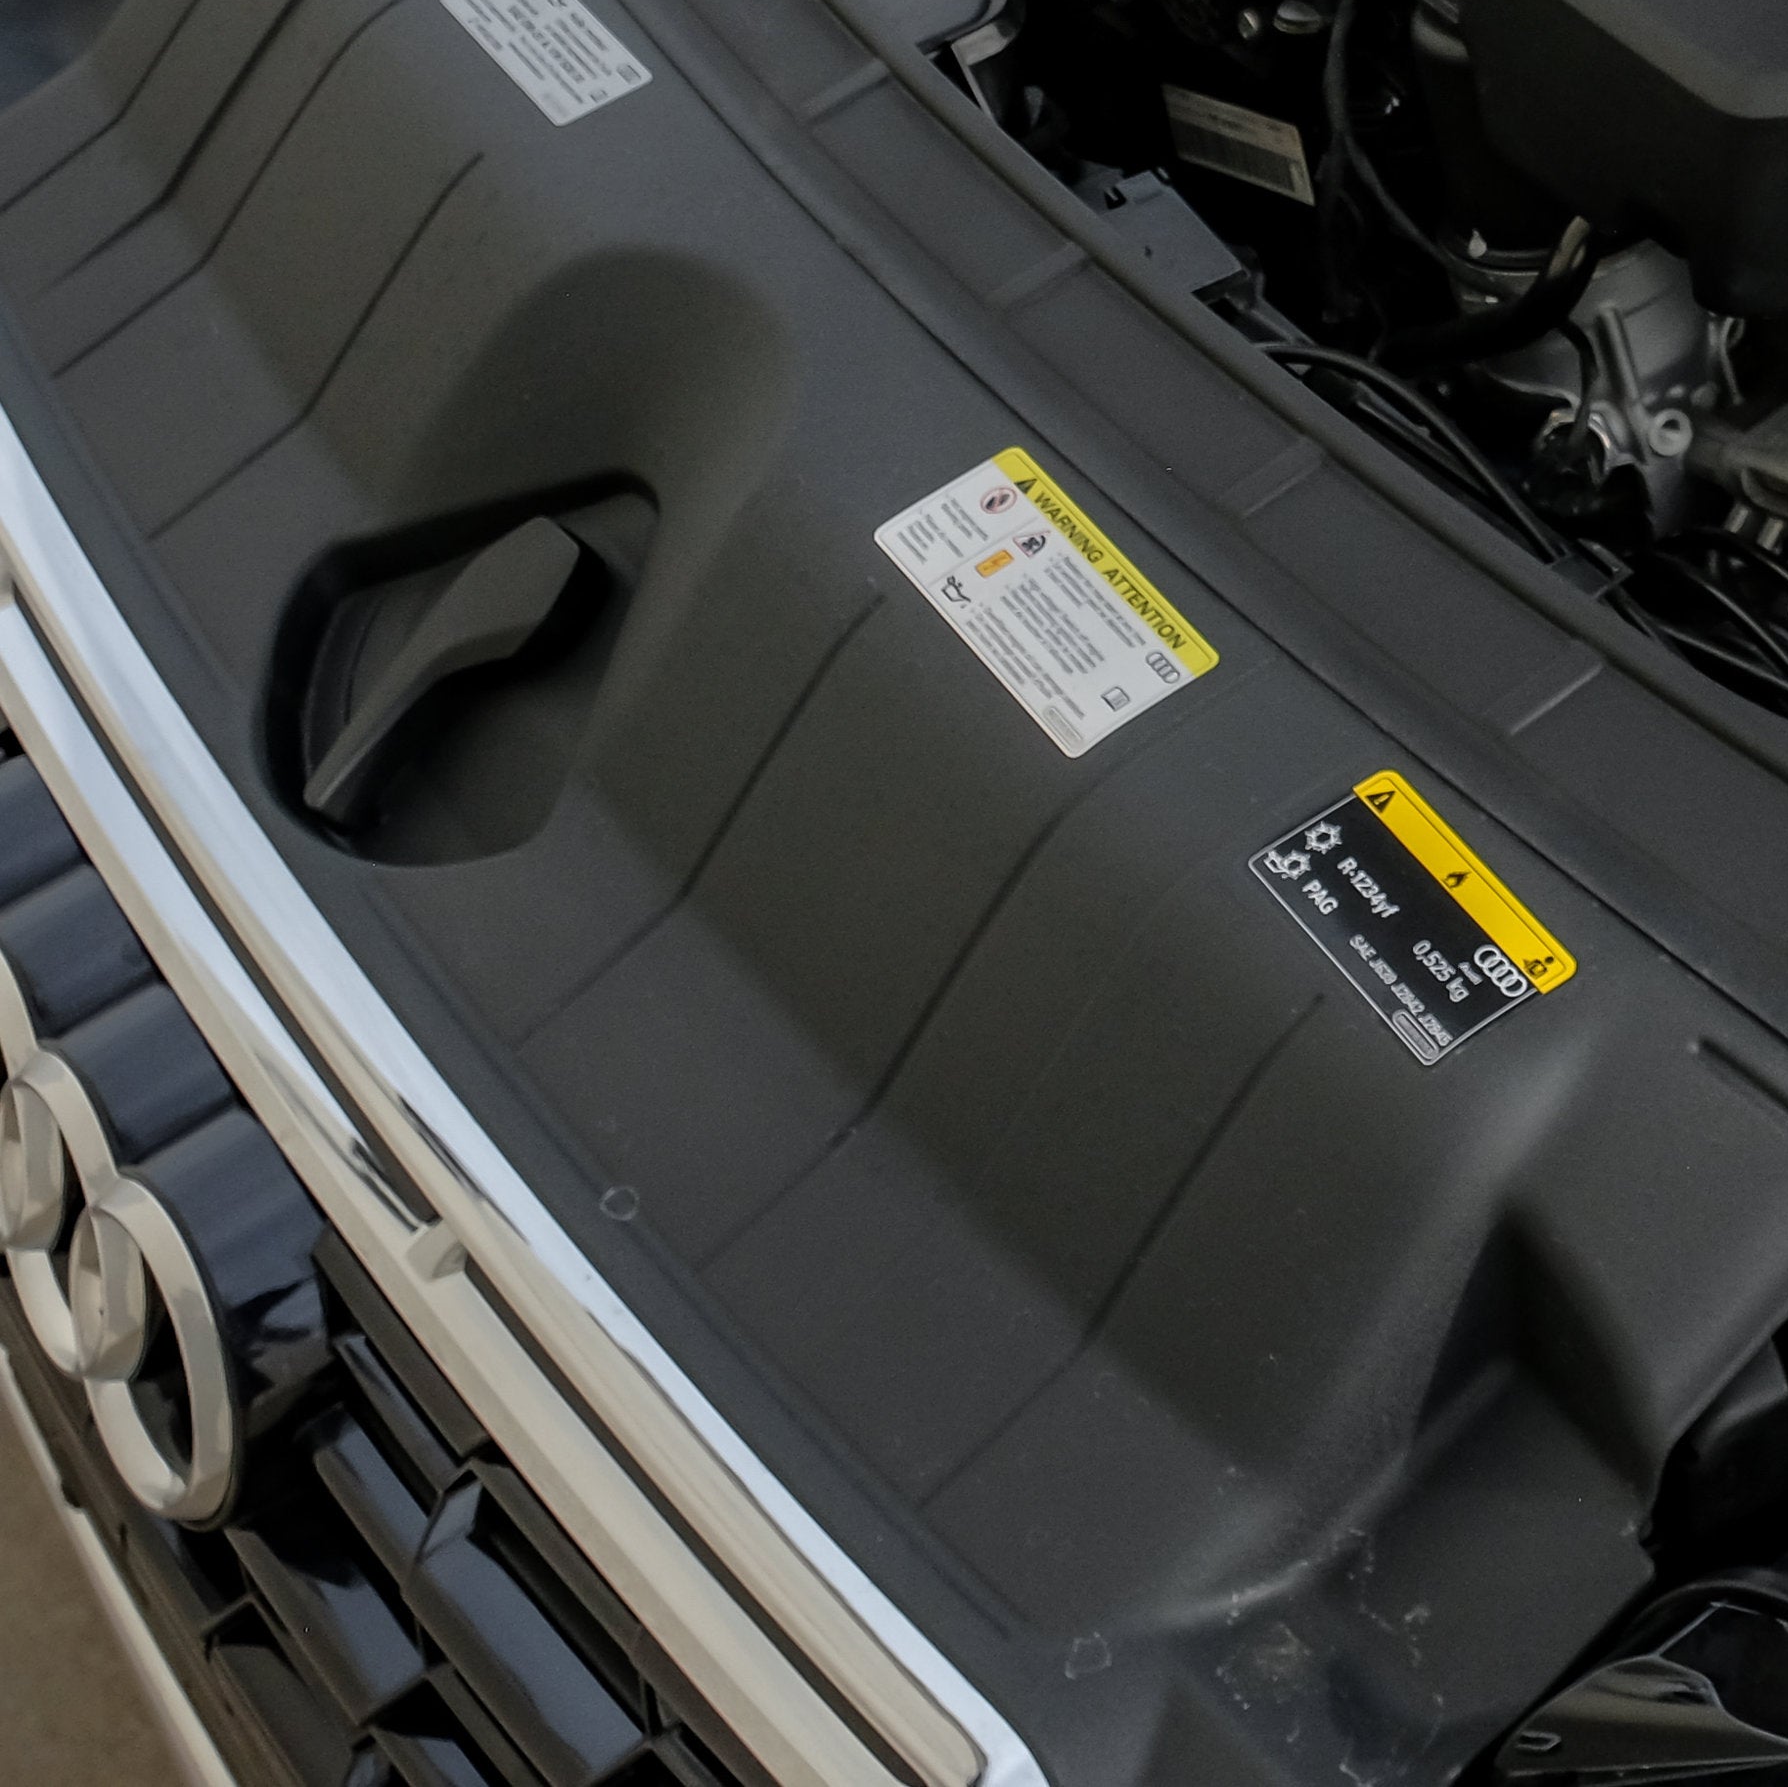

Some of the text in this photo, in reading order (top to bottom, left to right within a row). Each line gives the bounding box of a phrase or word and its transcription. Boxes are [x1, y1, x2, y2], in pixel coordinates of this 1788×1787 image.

[1035, 490, 1104, 563] WARNING
[1103, 568, 1188, 650] ATTENTION
[1302, 879, 1338, 916] PAG
[1350, 934, 1378, 961] SAE
[1337, 857, 1401, 918] R-1234yf
[1412, 940, 1457, 982] 0,525
[1446, 977, 1470, 1003] kg
